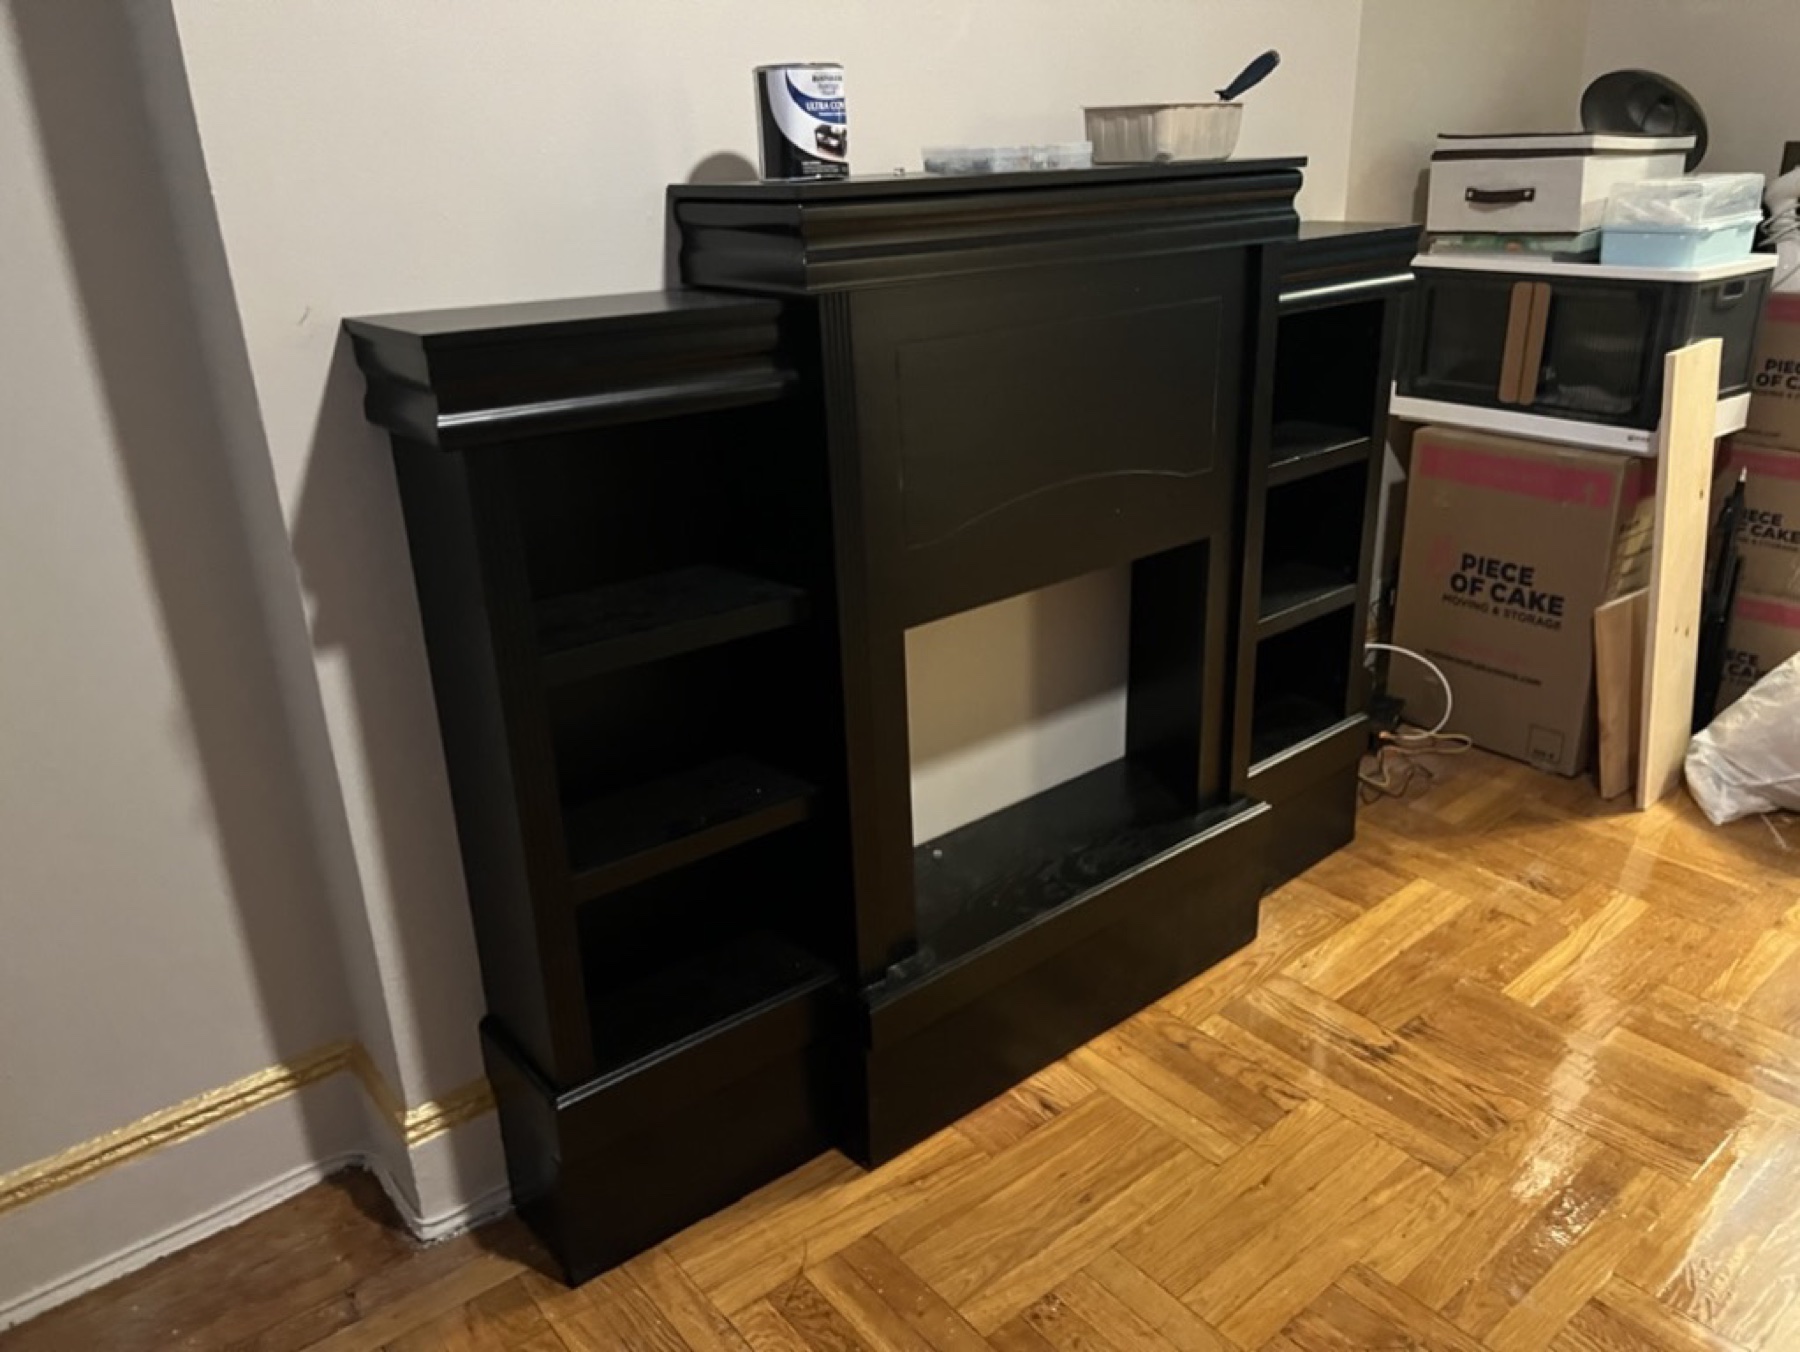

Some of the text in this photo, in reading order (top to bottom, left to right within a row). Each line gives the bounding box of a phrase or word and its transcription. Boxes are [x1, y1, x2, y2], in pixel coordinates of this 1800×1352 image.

[805, 101, 829, 111] ULTRA
[1756, 373, 1783, 387] OF
[1461, 552, 1535, 587] PIECE
[1442, 592, 1489, 613] MOVING
[1503, 608, 1562, 630] STORAGE
[1450, 572, 1565, 617] OF CAKE
